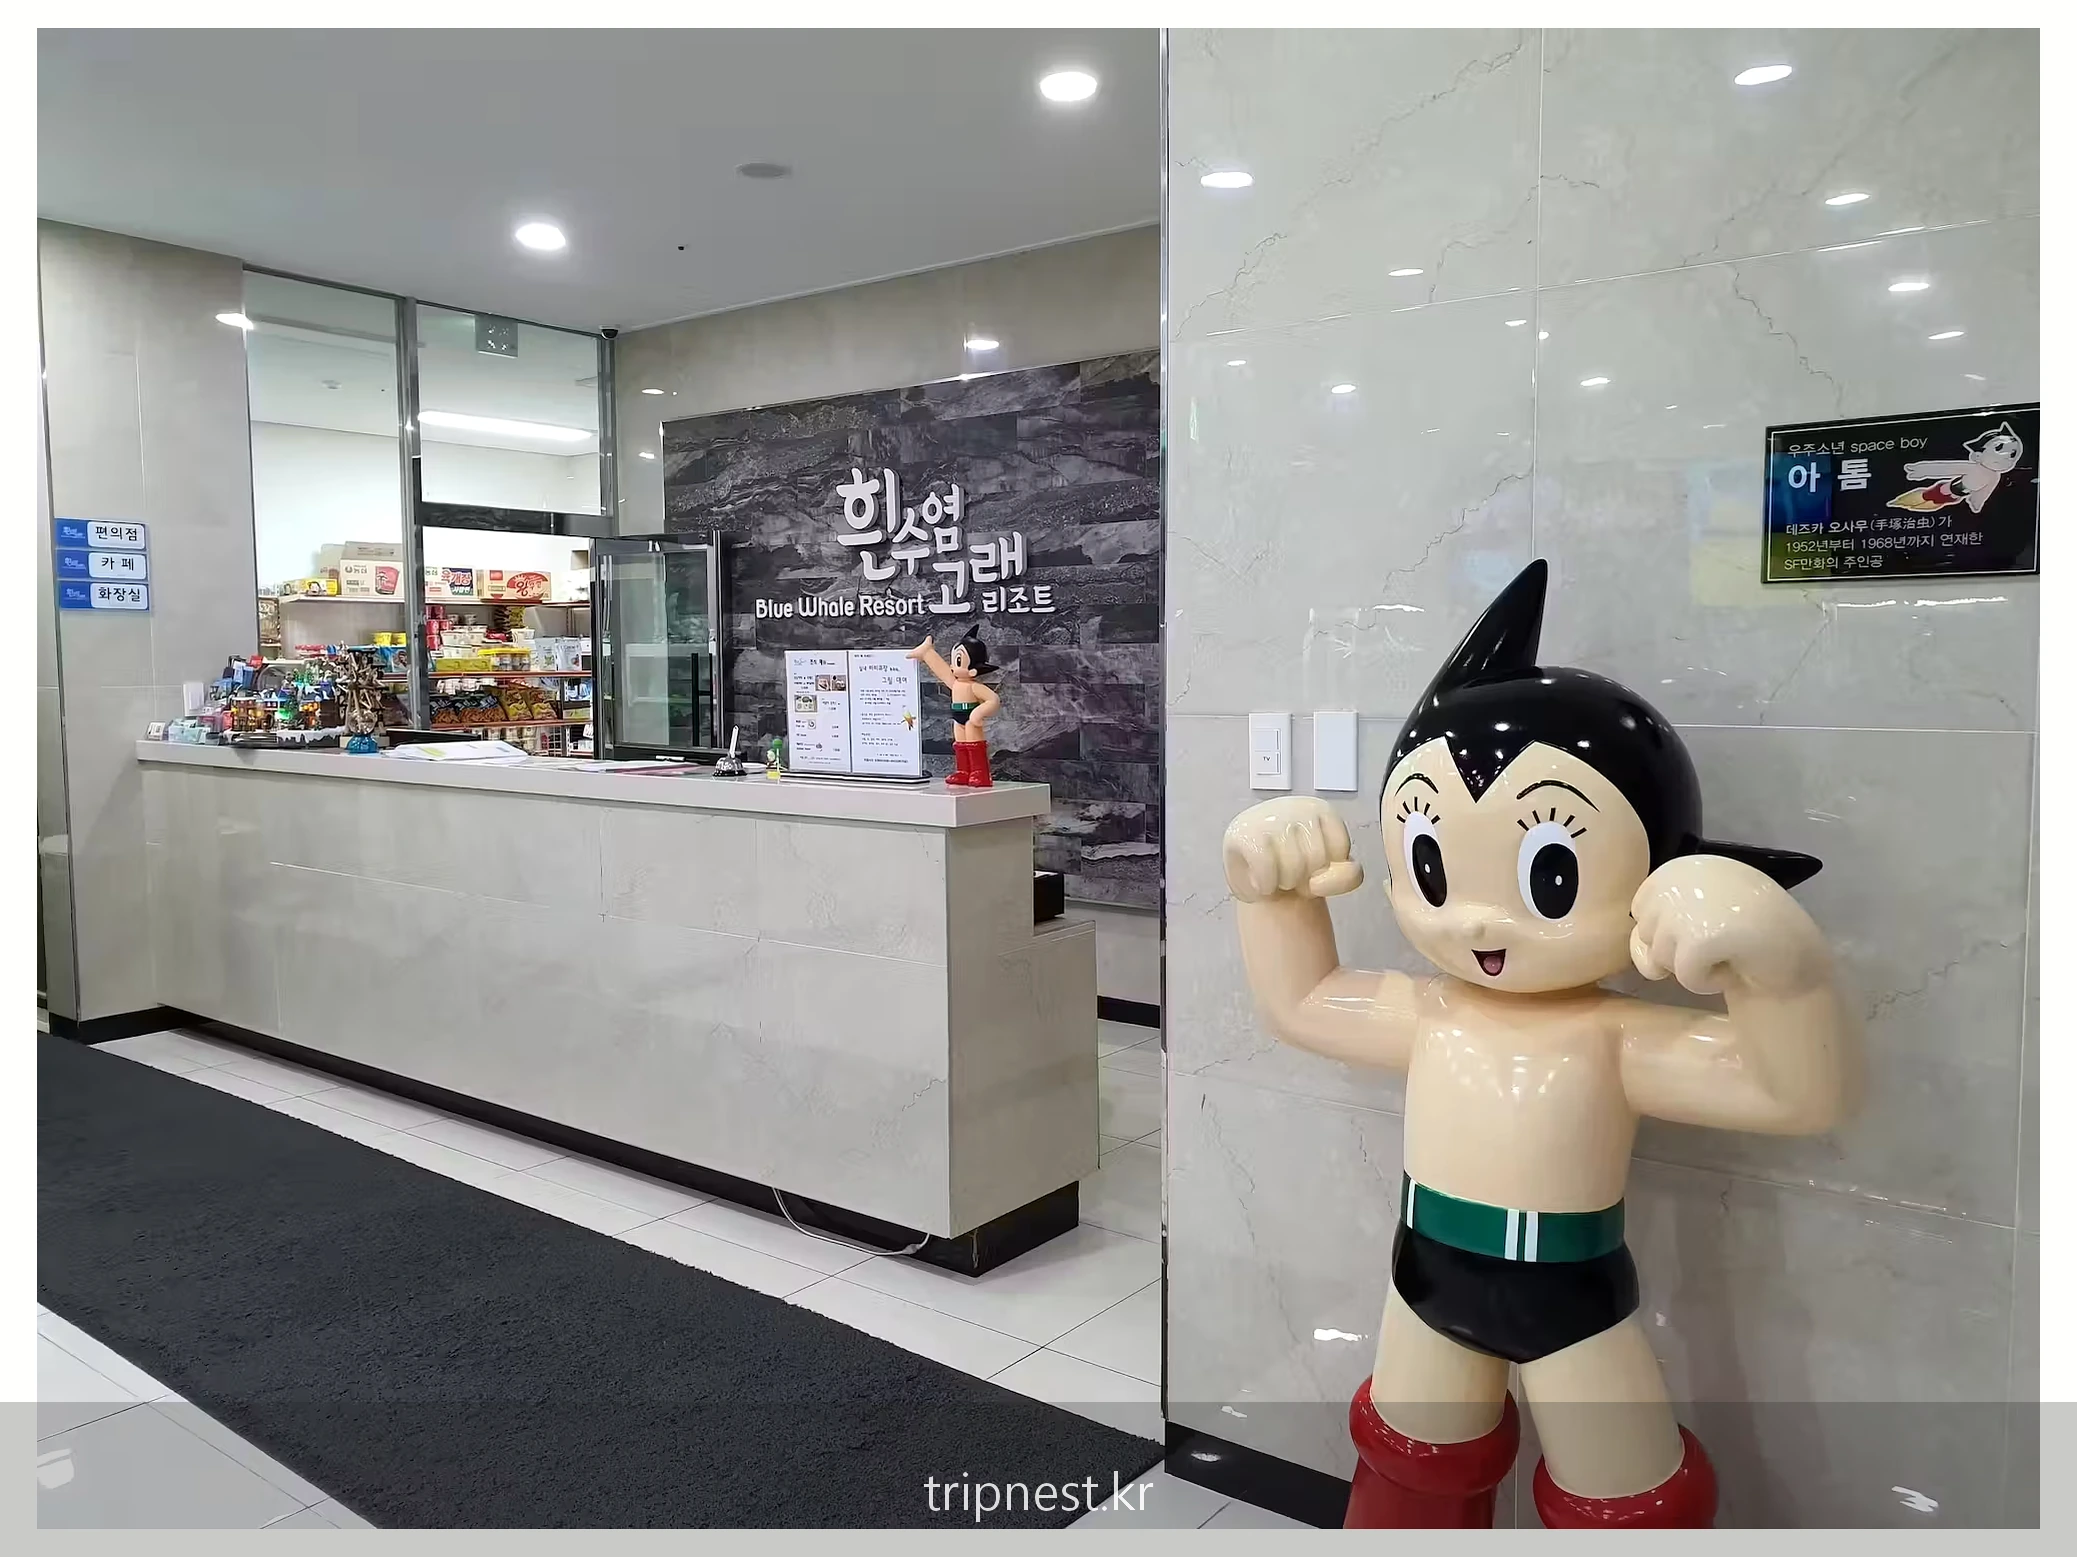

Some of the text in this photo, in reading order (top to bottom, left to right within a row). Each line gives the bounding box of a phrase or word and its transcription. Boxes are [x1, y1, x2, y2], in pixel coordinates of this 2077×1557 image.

[1787, 437, 1928, 457] 우주소년 space boy
[95, 526, 138, 541] 편의점
[1786, 523, 1824, 535] 데즈카
[1786, 532, 1983, 553] 1952년부터 1968년까지 연재한
[1784, 555, 1883, 571] SF만화의 주인공
[98, 587, 141, 602] 화장실
[982, 585, 1057, 614] 리조트
[755, 595, 928, 619] Blue Whale Resort
